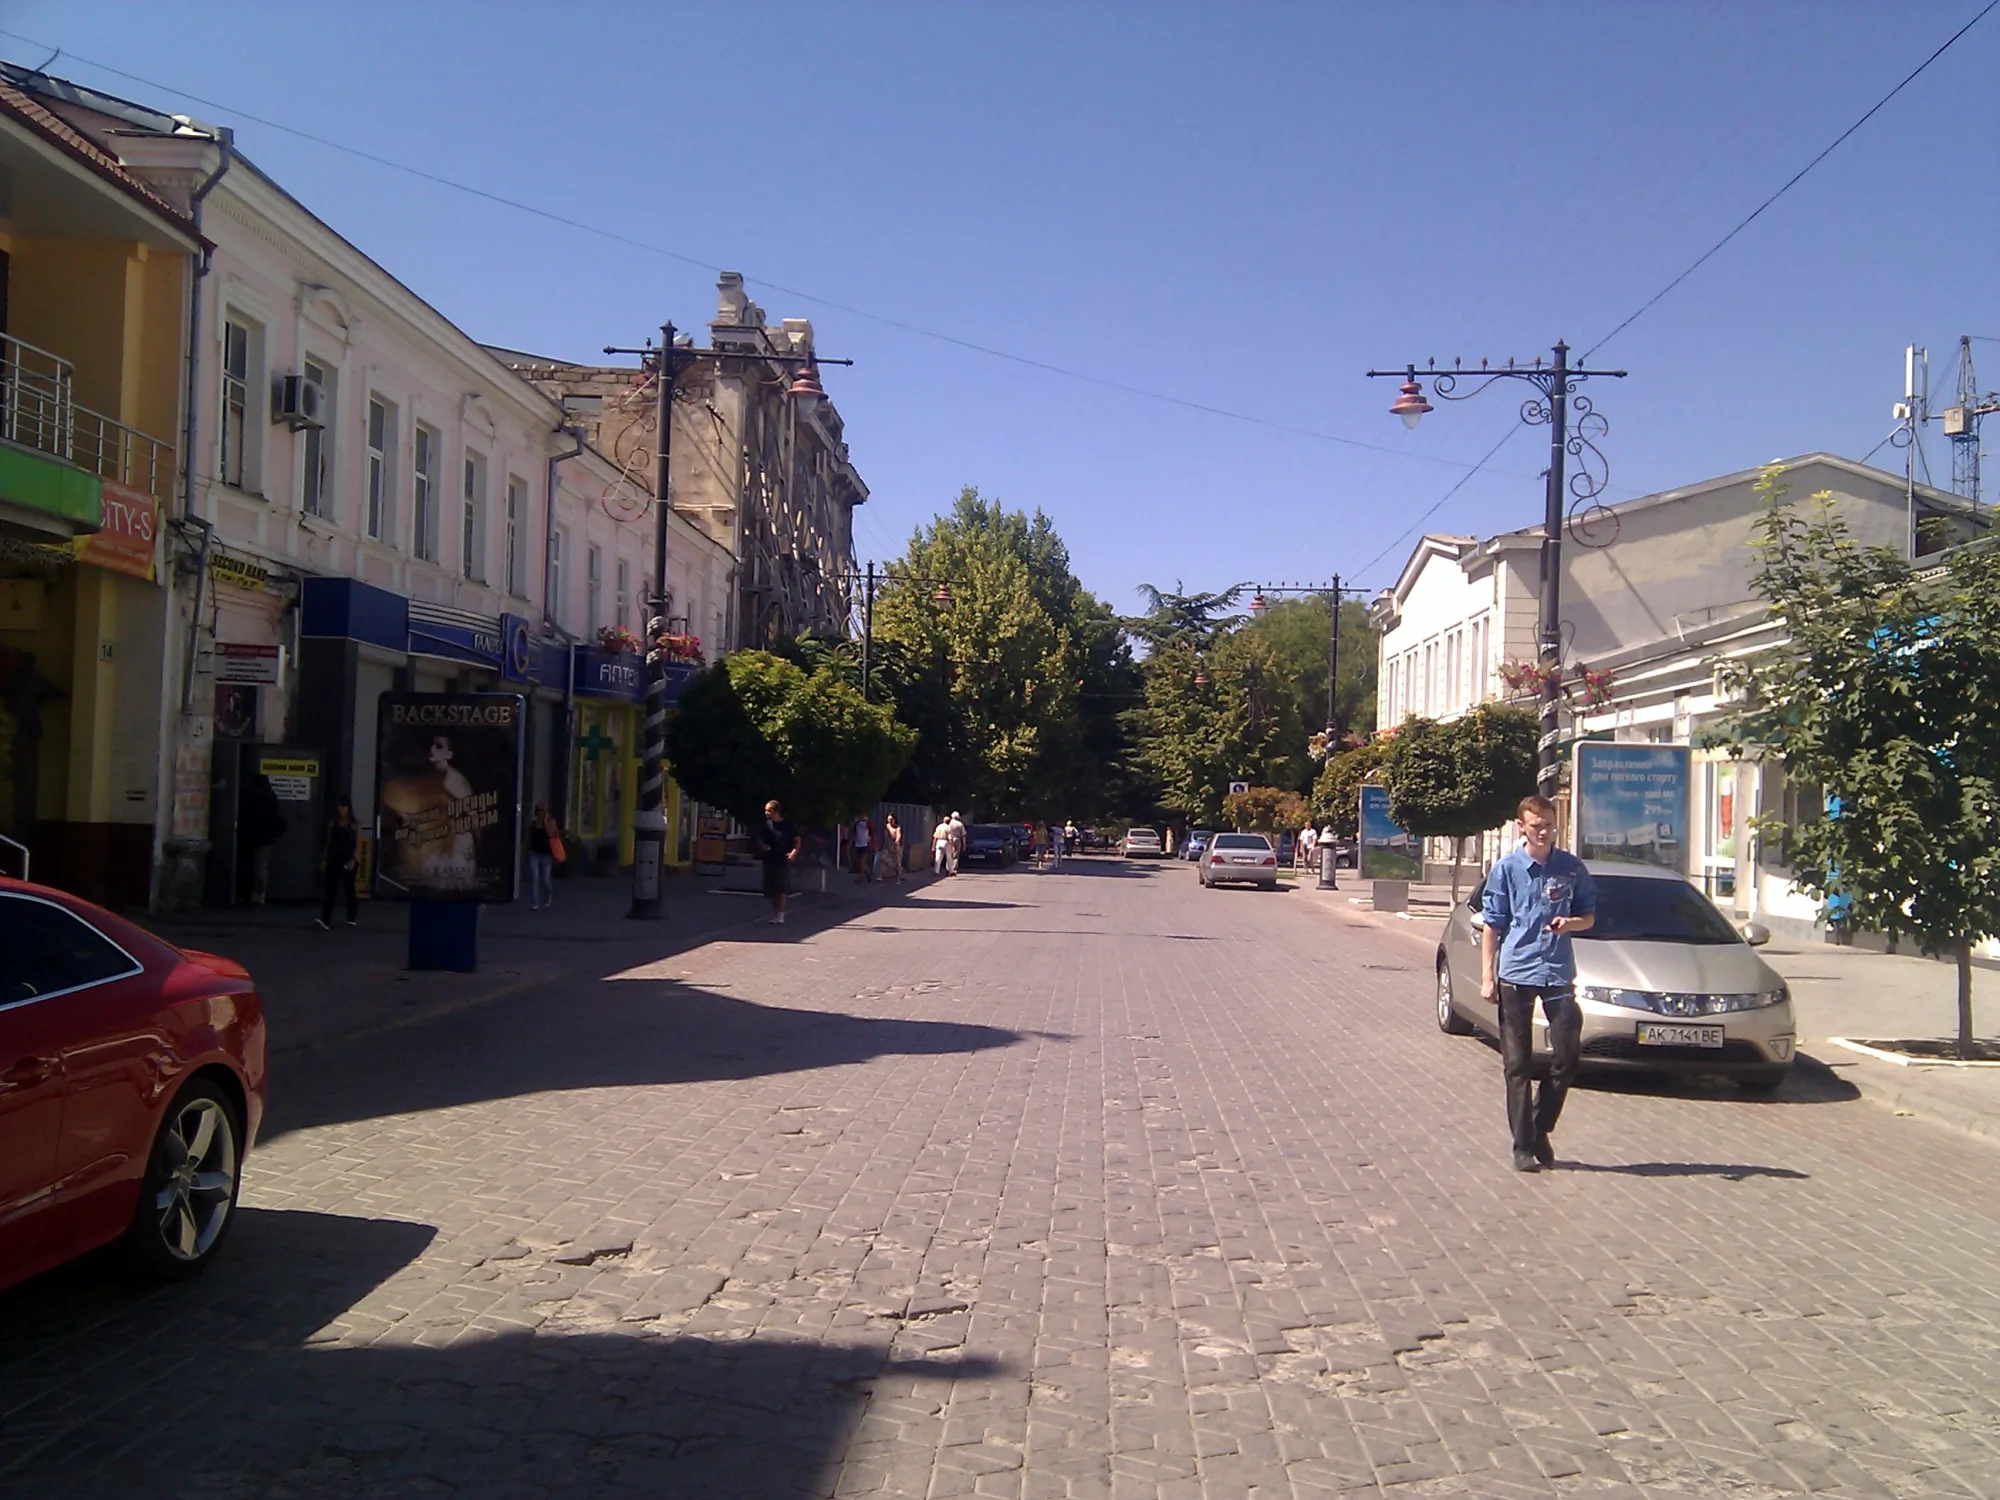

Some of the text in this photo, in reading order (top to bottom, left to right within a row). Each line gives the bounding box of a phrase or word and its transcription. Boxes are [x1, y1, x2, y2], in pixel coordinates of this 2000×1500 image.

[211, 554, 245, 575] SECOND
[245, 564, 268, 582] HAND
[102, 644, 113, 660] 14
[391, 704, 512, 724] BACKSTAGE
[1647, 773, 1677, 785] старту
[1648, 1027, 1719, 1043] AK 7141 BE
